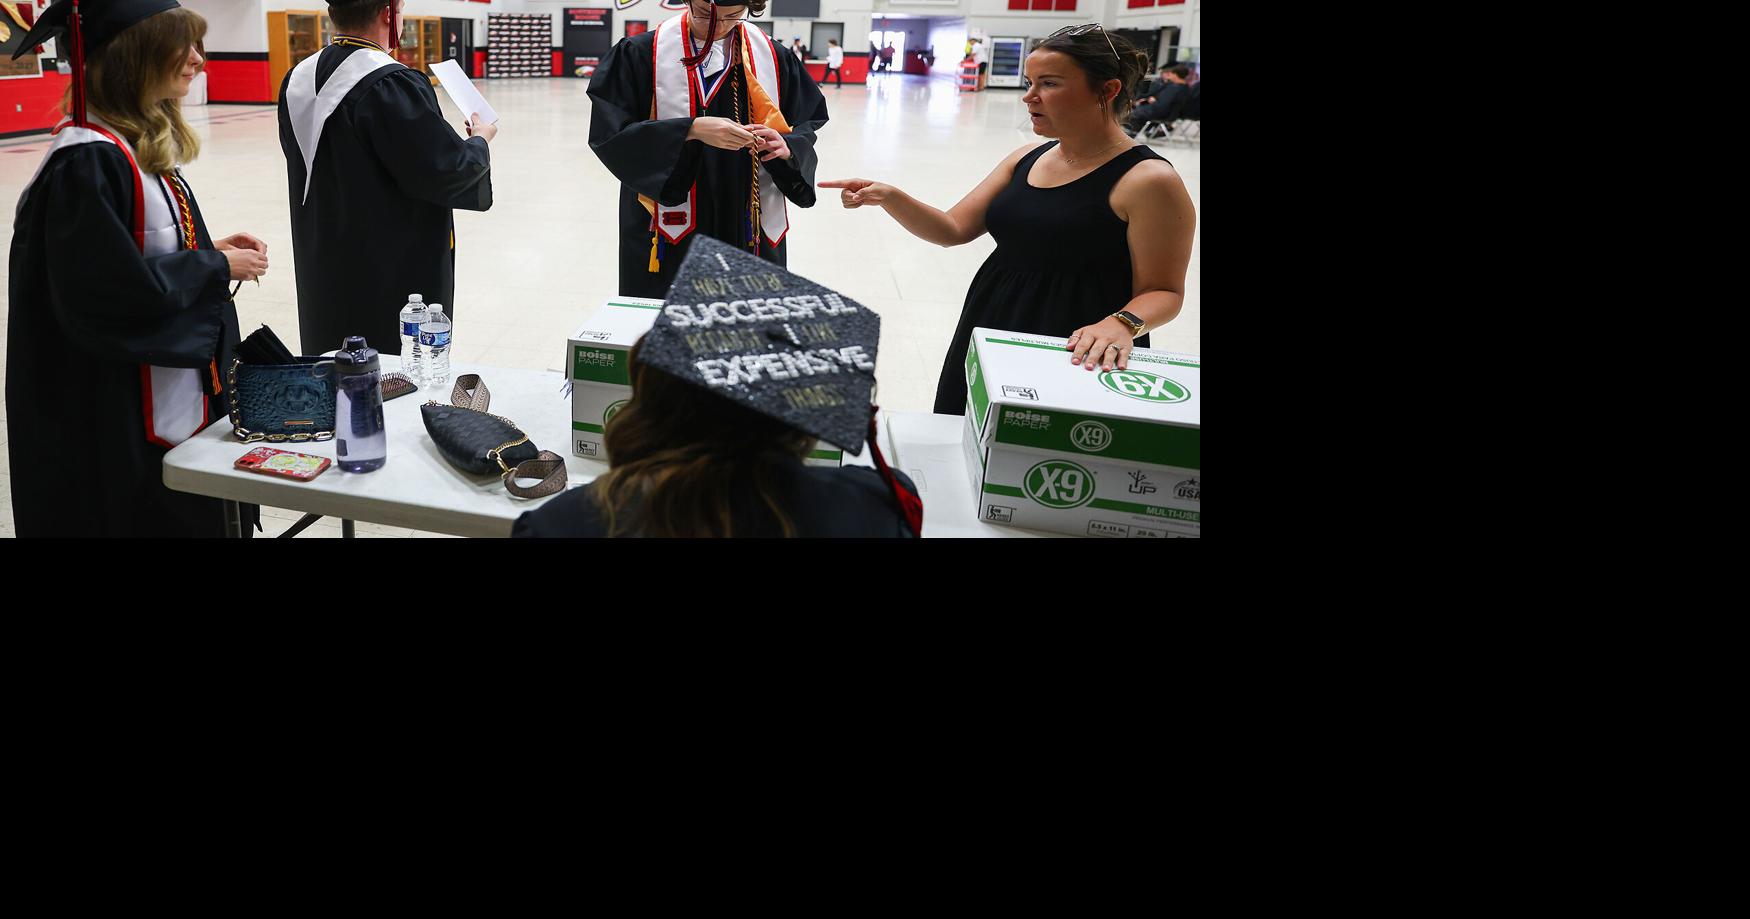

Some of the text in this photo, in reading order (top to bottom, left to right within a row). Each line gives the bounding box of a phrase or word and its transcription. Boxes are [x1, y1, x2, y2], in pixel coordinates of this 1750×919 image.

[715, 253, 731, 271] I
[665, 293, 858, 327] SUCCESSFUL
[578, 358, 616, 367] PAPER
[697, 345, 875, 385] EXPENSIVE
[1003, 417, 1050, 430] PAPER
[1078, 426, 1104, 446] X-9
[1036, 466, 1084, 502] X-9
[1145, 506, 1200, 520] MULTI-USE
